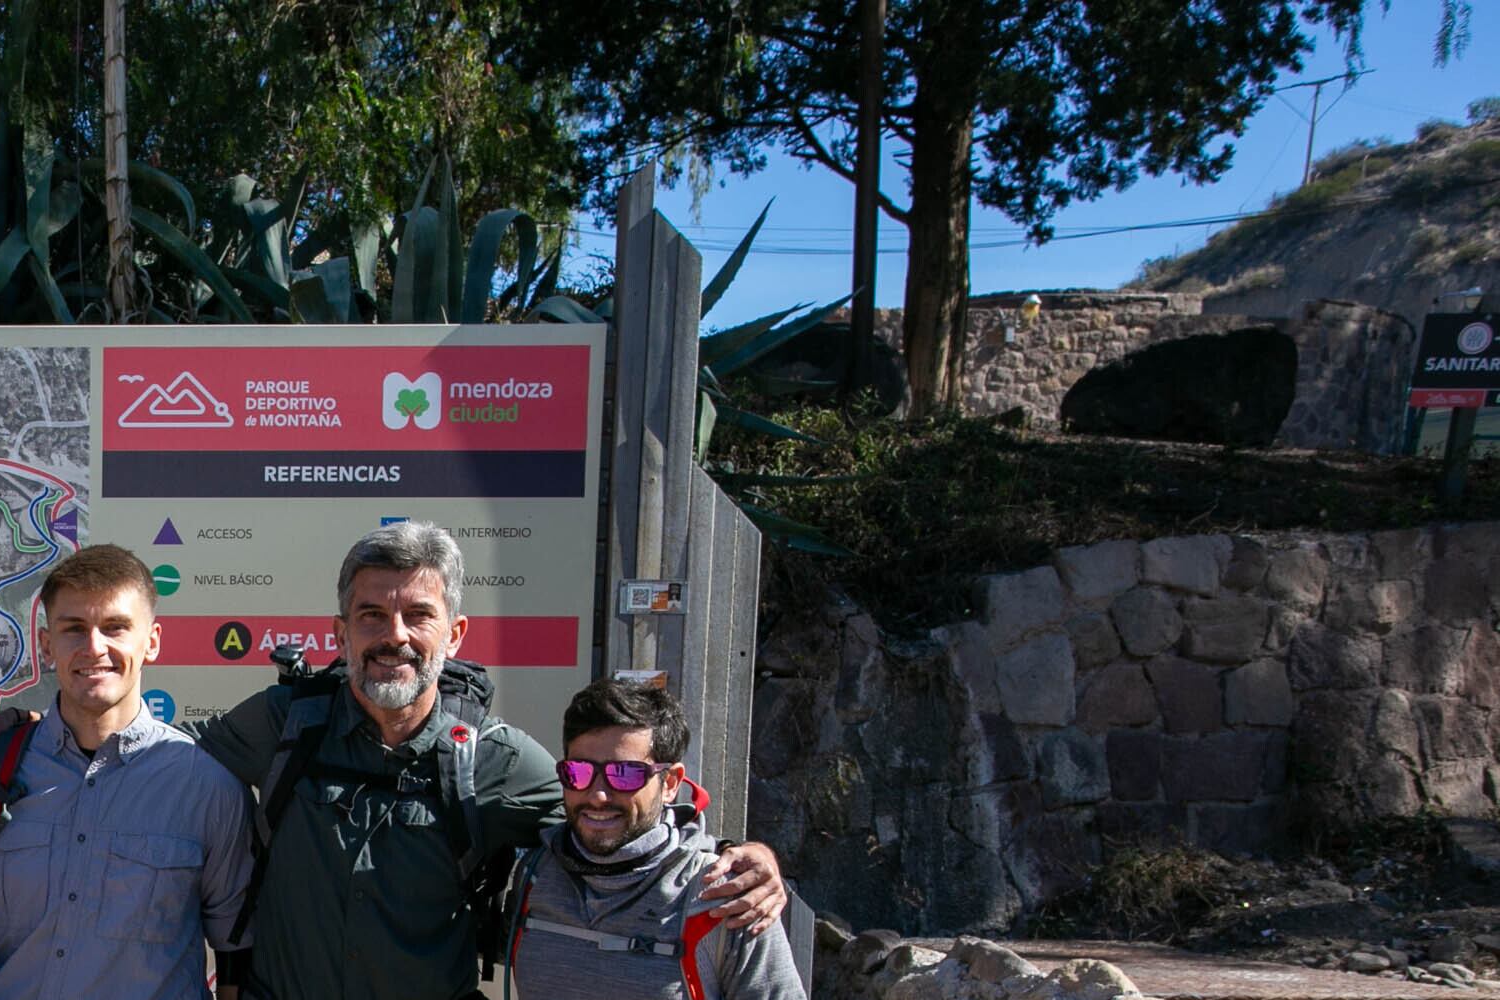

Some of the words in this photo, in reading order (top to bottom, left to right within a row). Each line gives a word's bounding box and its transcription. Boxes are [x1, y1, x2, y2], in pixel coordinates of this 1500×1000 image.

[1425, 357, 1500, 371] SANITAR
[246, 380, 309, 396] PARQUE
[449, 376, 553, 399] mendoza
[245, 396, 337, 411] DEPORTIVO
[244, 415, 257, 427] de
[260, 411, 342, 428] MONTAÑA
[449, 403, 519, 423] ciudad
[264, 465, 401, 483] REFERENCIAS
[197, 528, 252, 540] ACCESOS
[458, 527, 531, 538] INTERMEDIO
[194, 574, 227, 586] NIVEL
[229, 572, 274, 586] BÁSICO
[222, 628, 244, 651] A
[258, 628, 320, 651] ÁREA
